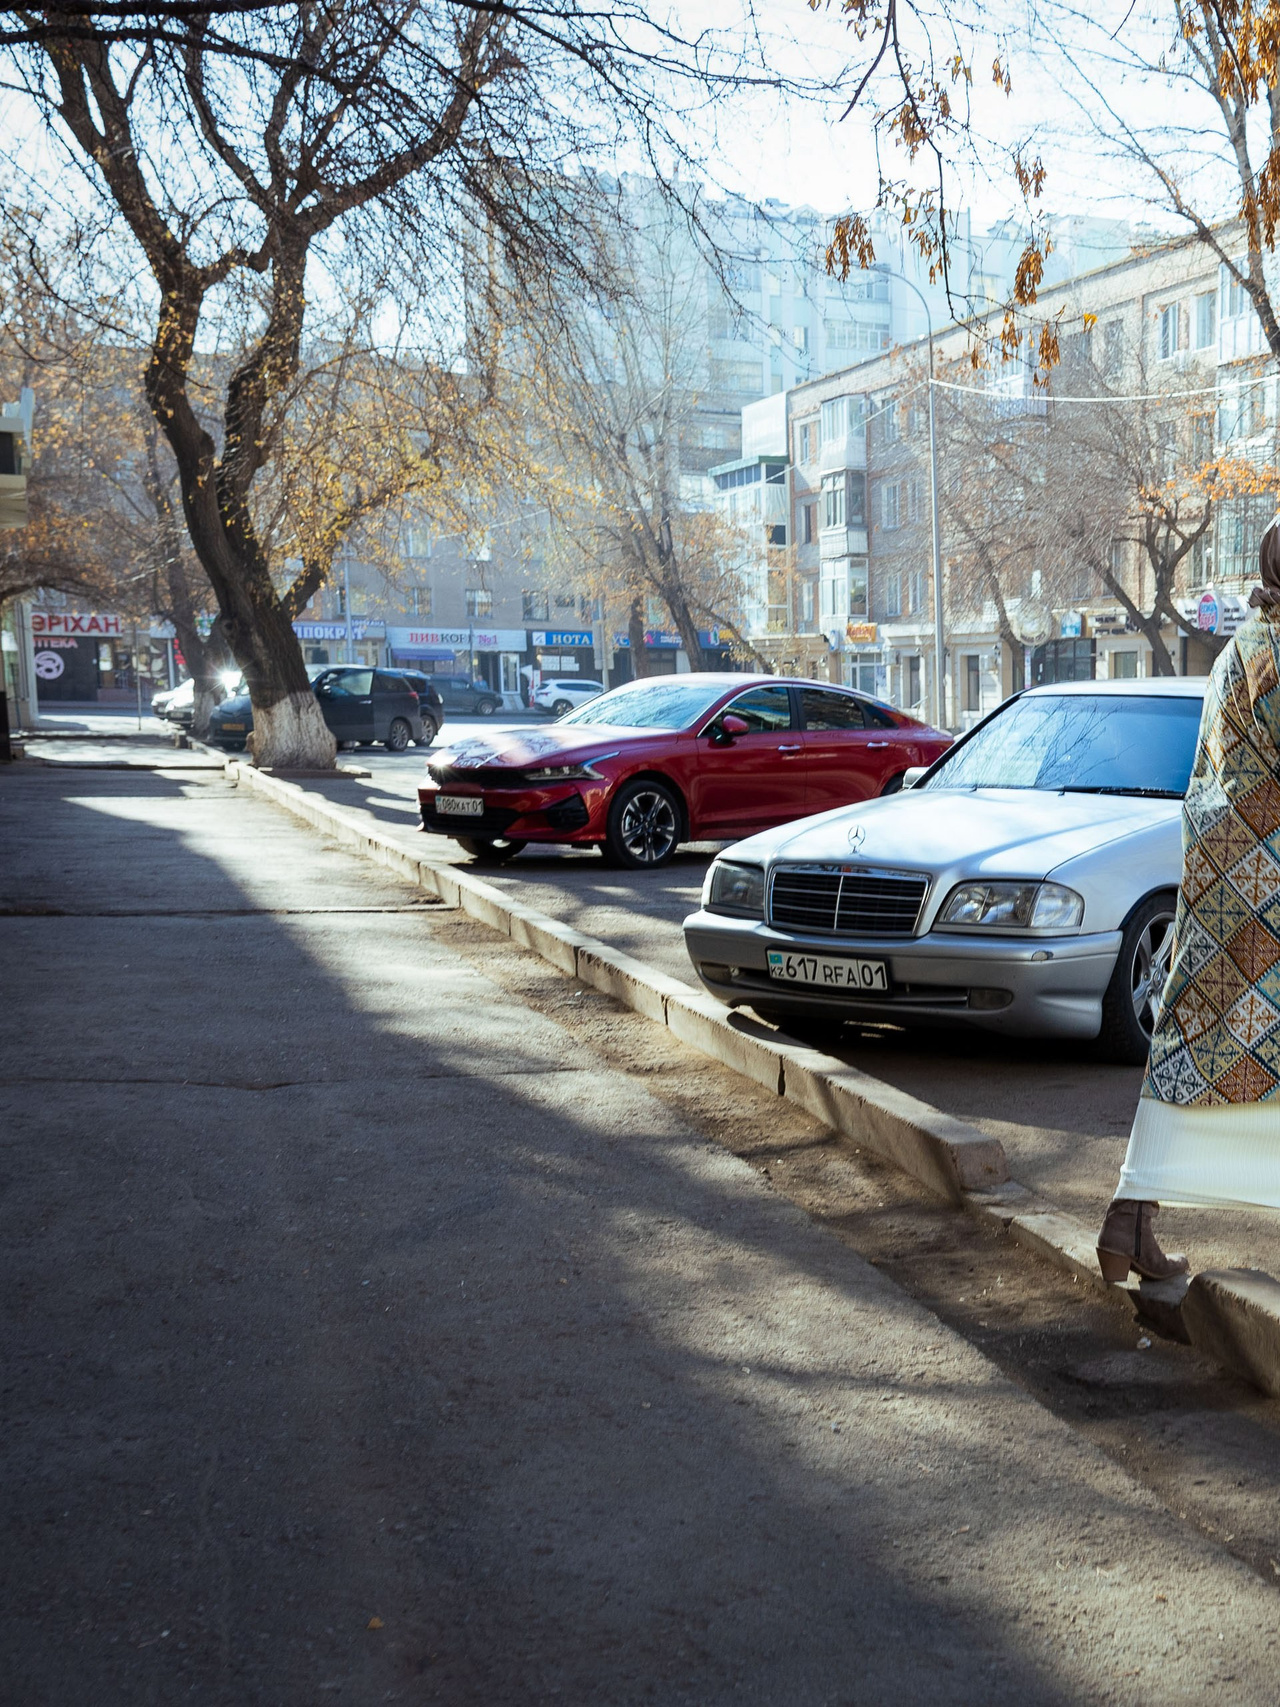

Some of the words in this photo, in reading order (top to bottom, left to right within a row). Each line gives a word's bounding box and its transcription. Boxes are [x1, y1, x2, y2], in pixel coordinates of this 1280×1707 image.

[785, 956, 818, 981] 617
[823, 964, 858, 986] RFA
[860, 963, 886, 988] 01
